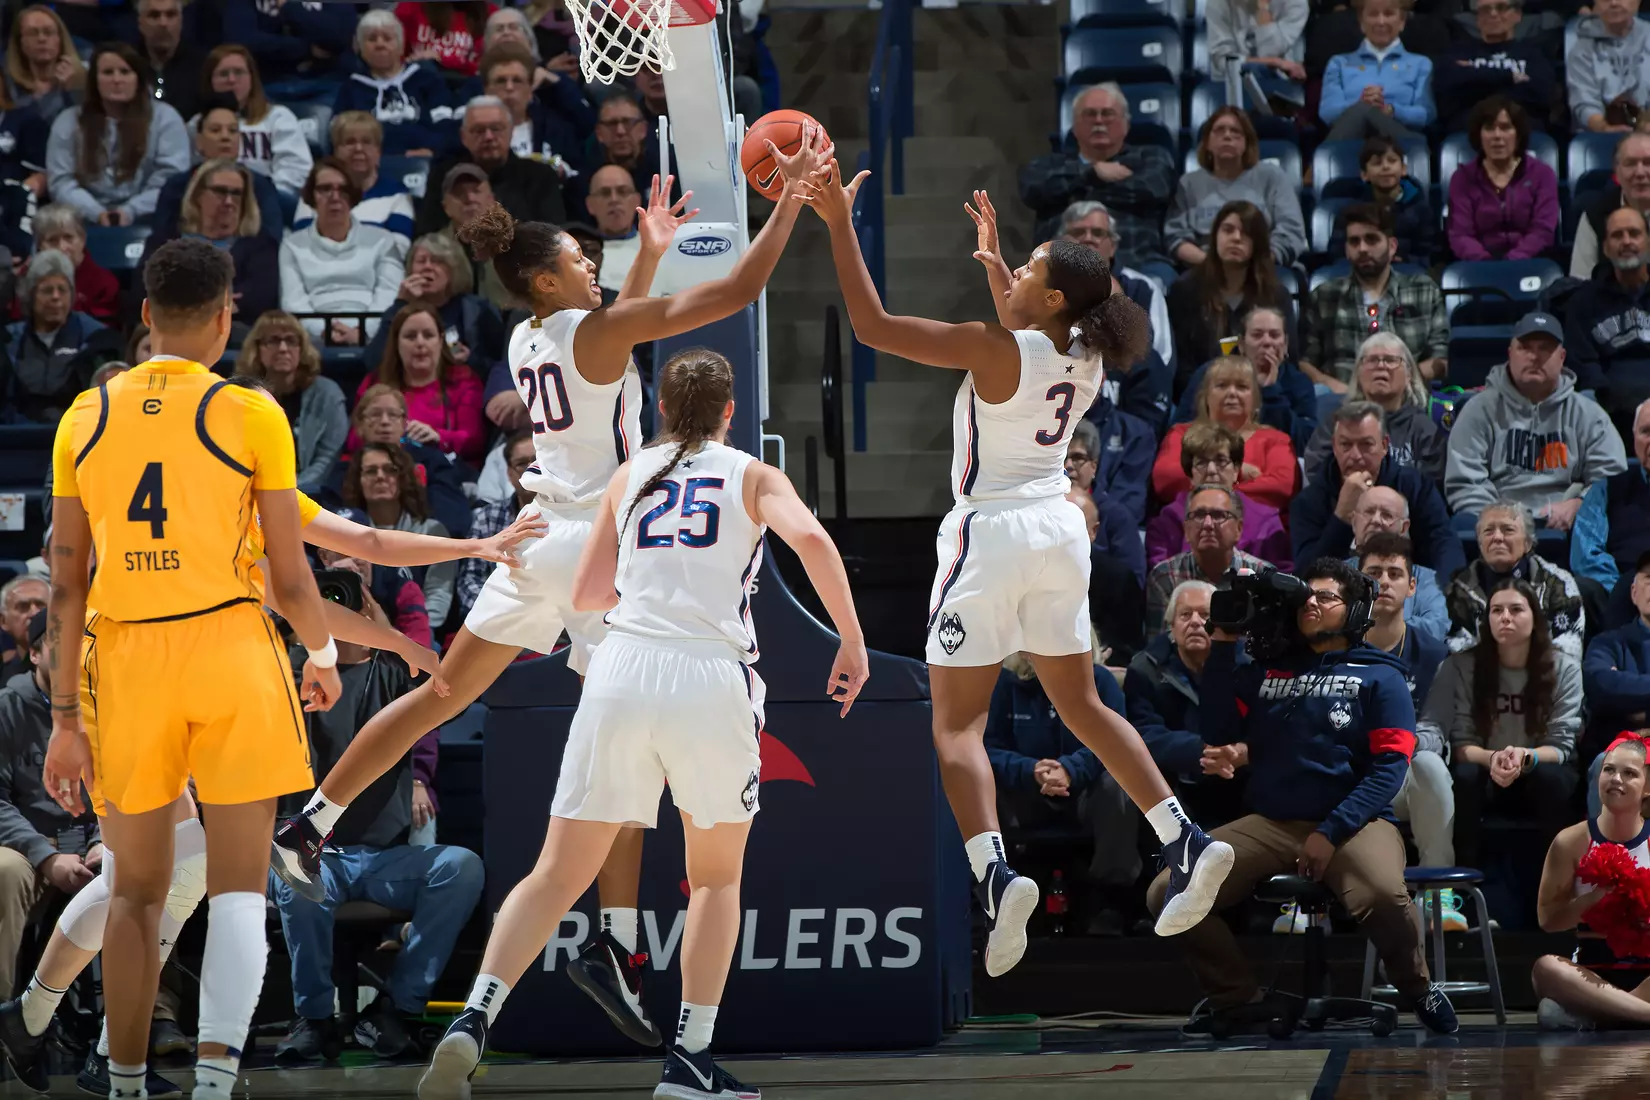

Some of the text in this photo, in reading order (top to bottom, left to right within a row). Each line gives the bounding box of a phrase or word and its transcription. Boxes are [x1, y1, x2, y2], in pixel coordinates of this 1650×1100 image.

[679, 241, 727, 250] SNA
[518, 362, 574, 434] 20
[1035, 381, 1076, 446] 3
[127, 462, 168, 539] 4
[636, 477, 725, 549] 25
[124, 550, 180, 571] STYLES
[1258, 674, 1363, 701] HUSKIES
[493, 907, 923, 973] RVLERS
